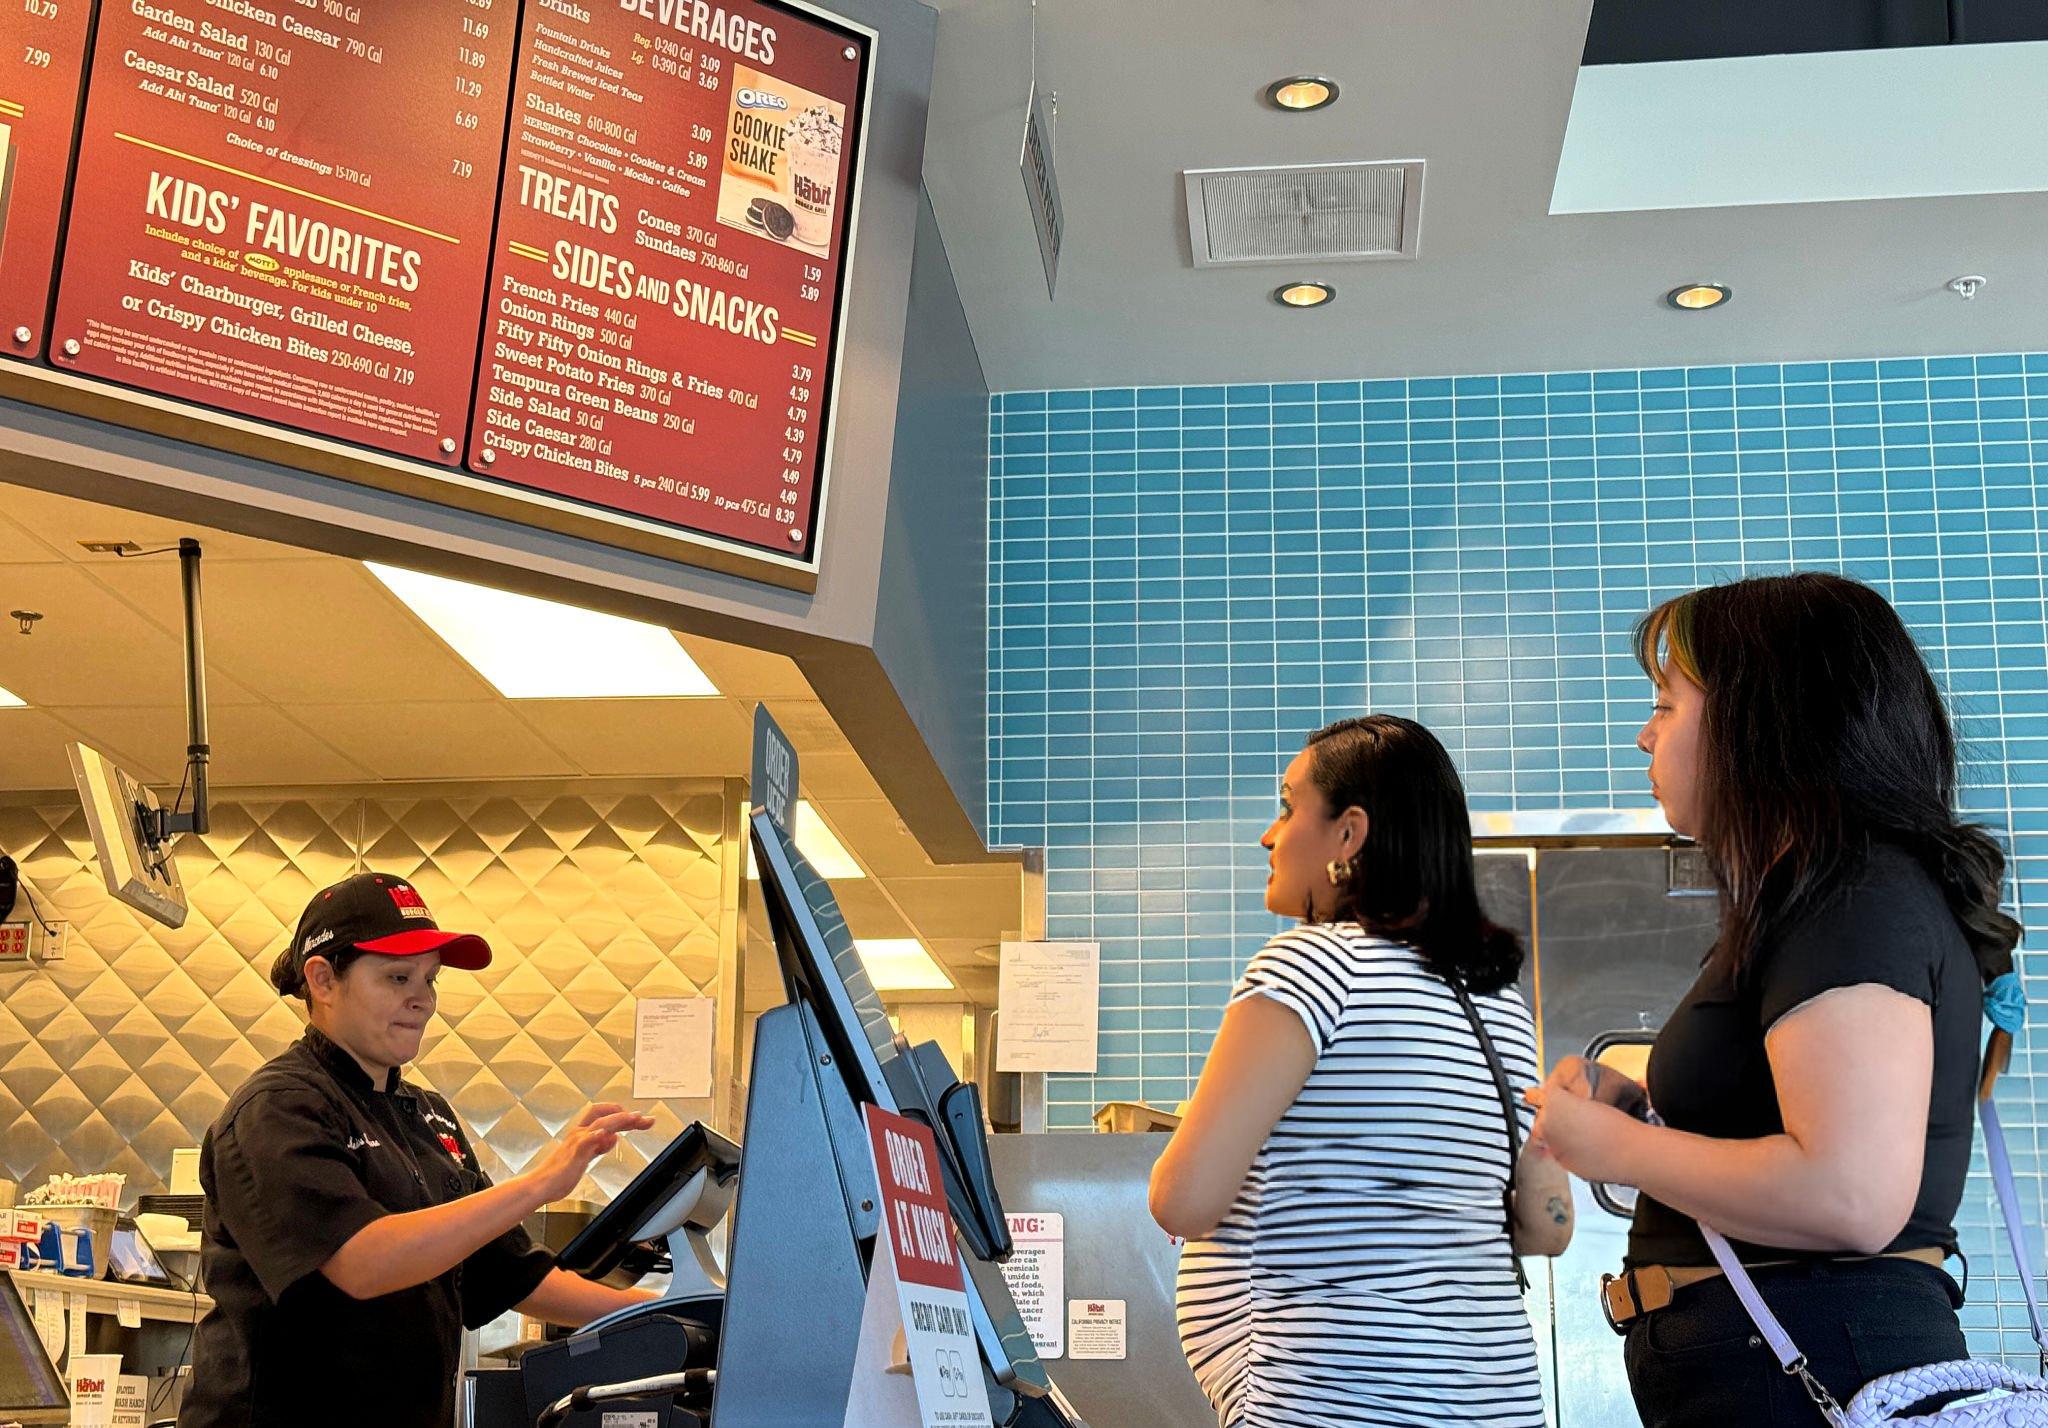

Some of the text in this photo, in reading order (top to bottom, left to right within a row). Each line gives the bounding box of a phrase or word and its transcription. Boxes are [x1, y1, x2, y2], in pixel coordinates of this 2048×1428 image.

[25, 0, 58, 20] 10.79
[463, 17, 489, 39] 11.69
[131, 0, 291, 66] Garden Salad 130 Cal
[205, 0, 382, 64] icken Caesar 790 Cal
[535, 22, 611, 58] Fountain Drinks
[24, 46, 51, 68] 7.99
[459, 46, 485, 68] 11.89
[533, 38, 624, 79] Handcrafted Juices
[630, 50, 718, 91] Lg. 0-390 Cal 3.69
[632, 32, 720, 73] Reg. 0-240 Cal 3.09
[124, 49, 278, 115] Caesar Salad 520 Cal
[455, 76, 482, 98] 11.29
[531, 53, 643, 103] Fresh Brewed Iced Teas
[525, 92, 637, 144] Shakes 610-800 Cal
[737, 89, 788, 110] OREO
[455, 110, 478, 130] 6.69
[691, 123, 711, 143] 3.09
[733, 111, 786, 151] COOKIE
[452, 158, 472, 178] 7.19
[520, 130, 576, 159] Strawberry
[584, 151, 616, 172] Vanilla
[623, 166, 654, 185] Mocha
[661, 179, 690, 197] Coffee
[522, 113, 574, 141] HERSHEY'S
[576, 133, 622, 157] Chocolate
[629, 152, 665, 173] Cookies
[666, 165, 674, 176] &
[676, 169, 706, 187] Cream
[686, 150, 708, 169] 5.89
[730, 138, 778, 175] SHAKE
[518, 164, 619, 233] TREATS
[794, 173, 832, 206] Habit
[145, 171, 421, 291] KIDS' FAVORITES
[637, 208, 717, 248] Cones 370 Cal
[144, 223, 190, 245] Includes
[191, 238, 226, 256] choice
[227, 249, 239, 260] of
[282, 266, 338, 289] applesauce
[339, 283, 351, 292] or
[352, 284, 386, 303] French
[387, 295, 412, 312] fries,
[180, 249, 377, 313] and a kids' beverage. For kids under 10
[804, 264, 821, 282] 1.59
[128, 259, 415, 357] Kids' Charburger, Grilled Cheese,
[502, 274, 637, 329] French Fries 440 Cal
[552, 239, 778, 344] SIDES AND SNACKS
[800, 284, 819, 302] 5.89
[121, 295, 143, 311] or
[147, 298, 206, 332] Crispy
[210, 315, 282, 350] Chicken
[285, 336, 329, 362] Bites
[330, 349, 372, 374] 250-690
[374, 361, 390, 379] Cal
[393, 366, 414, 385] 7.19
[494, 341, 671, 406] Sweet Potato Fries 370 Cal
[496, 318, 758, 409] Fifty Fifty Onion Rings & Fries 470 Cal
[791, 364, 811, 382] 3.79
[492, 363, 695, 434] Tempura Green Beans 250 Cal
[787, 405, 807, 423] 4.79
[789, 385, 809, 403] 4.39
[784, 426, 804, 443] 4.39
[782, 446, 802, 464] 4.79
[483, 429, 796, 524] Crispy Chicken Bites 5 pcs 240 Cal 5.99 10 pcs 475 Cal 8.39
[782, 468, 800, 484] 4.49
[779, 488, 797, 505] 4.49
[765, 727, 790, 799] ORDER
[885, 1128, 932, 1196] ORDER
[894, 1199, 954, 1267] AT KIOSK
[1021, 1281, 1045, 1289] foods,
[1022, 1289, 1045, 1297] which
[911, 1301, 970, 1338] CREDIT CARD ONLY
[76, 1378, 105, 1393] Habit
